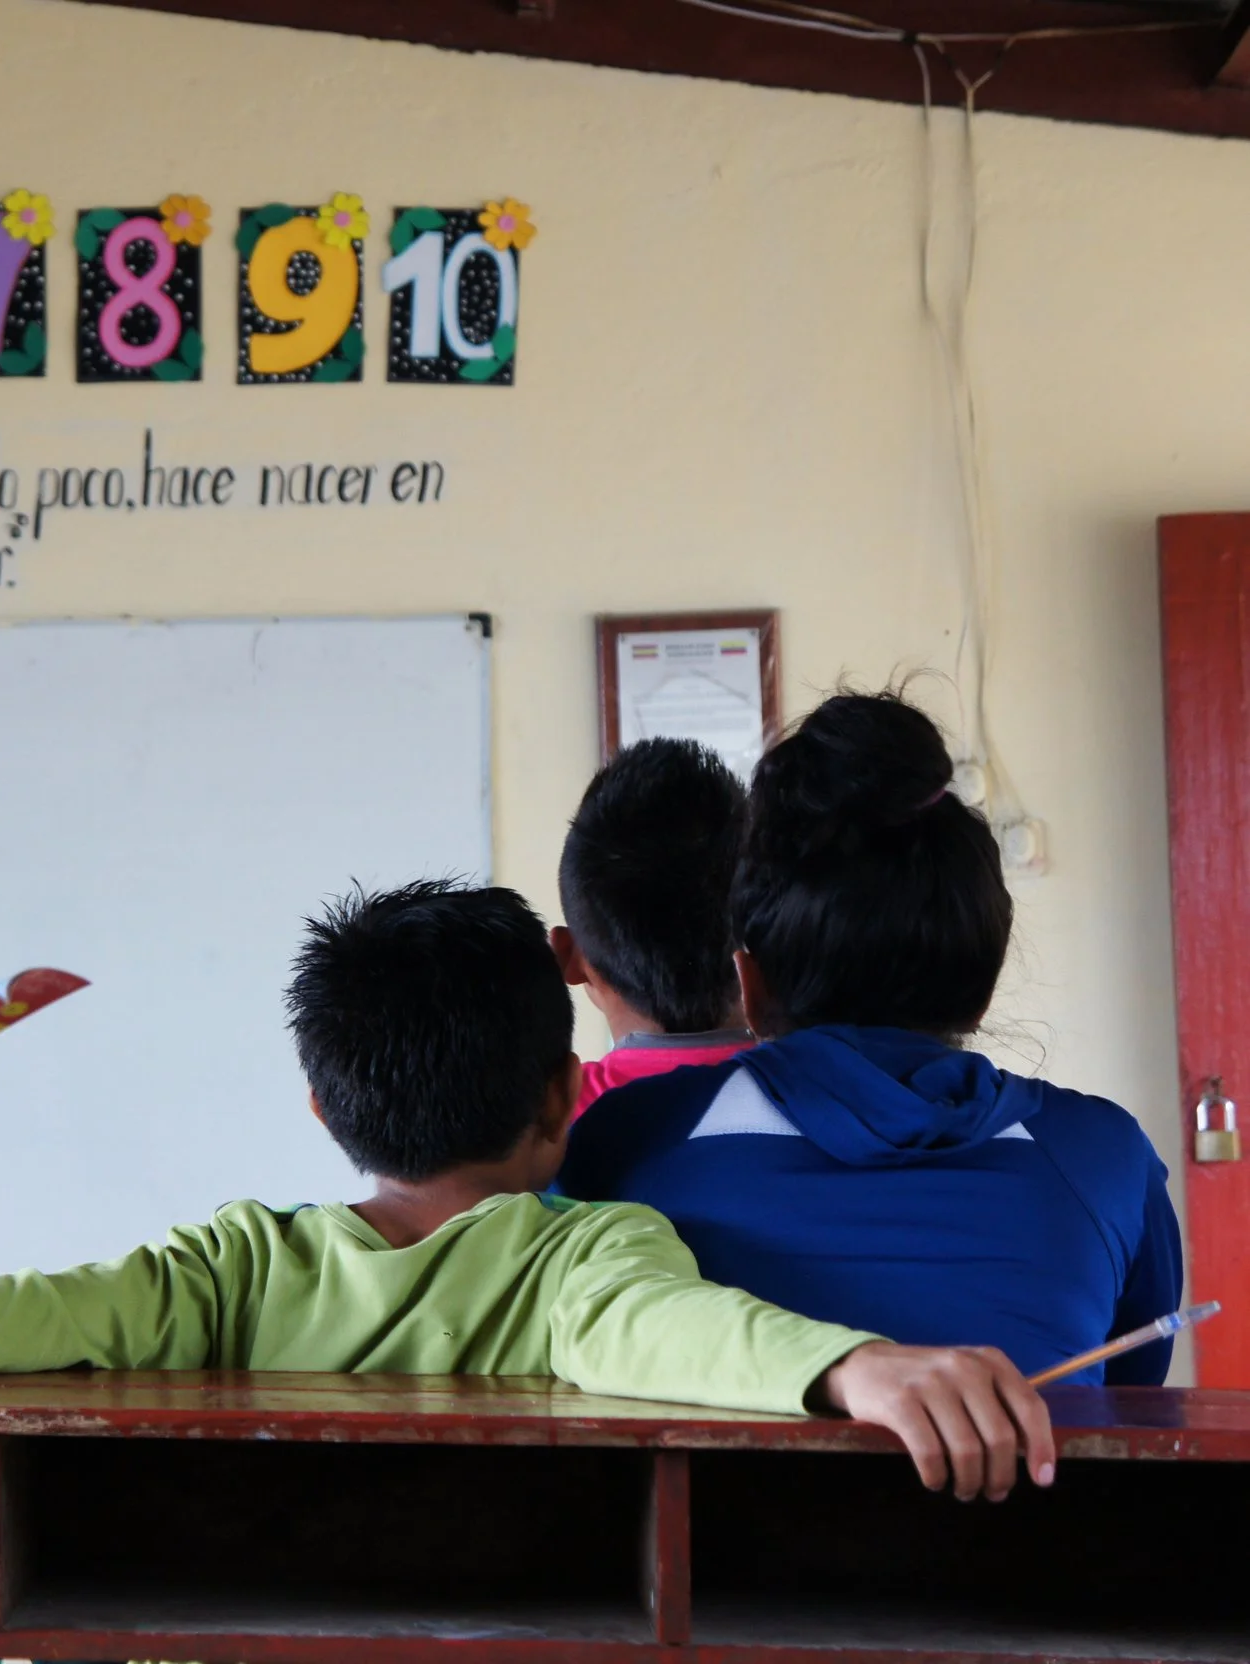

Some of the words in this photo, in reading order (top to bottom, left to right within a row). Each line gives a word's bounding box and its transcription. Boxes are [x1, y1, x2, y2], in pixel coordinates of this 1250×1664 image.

[98, 217, 181, 366] 8
[248, 216, 358, 373] 9
[382, 232, 517, 360] 10
[141, 428, 235, 508] hace
[259, 460, 377, 506] nacer
[391, 459, 444, 504] en
